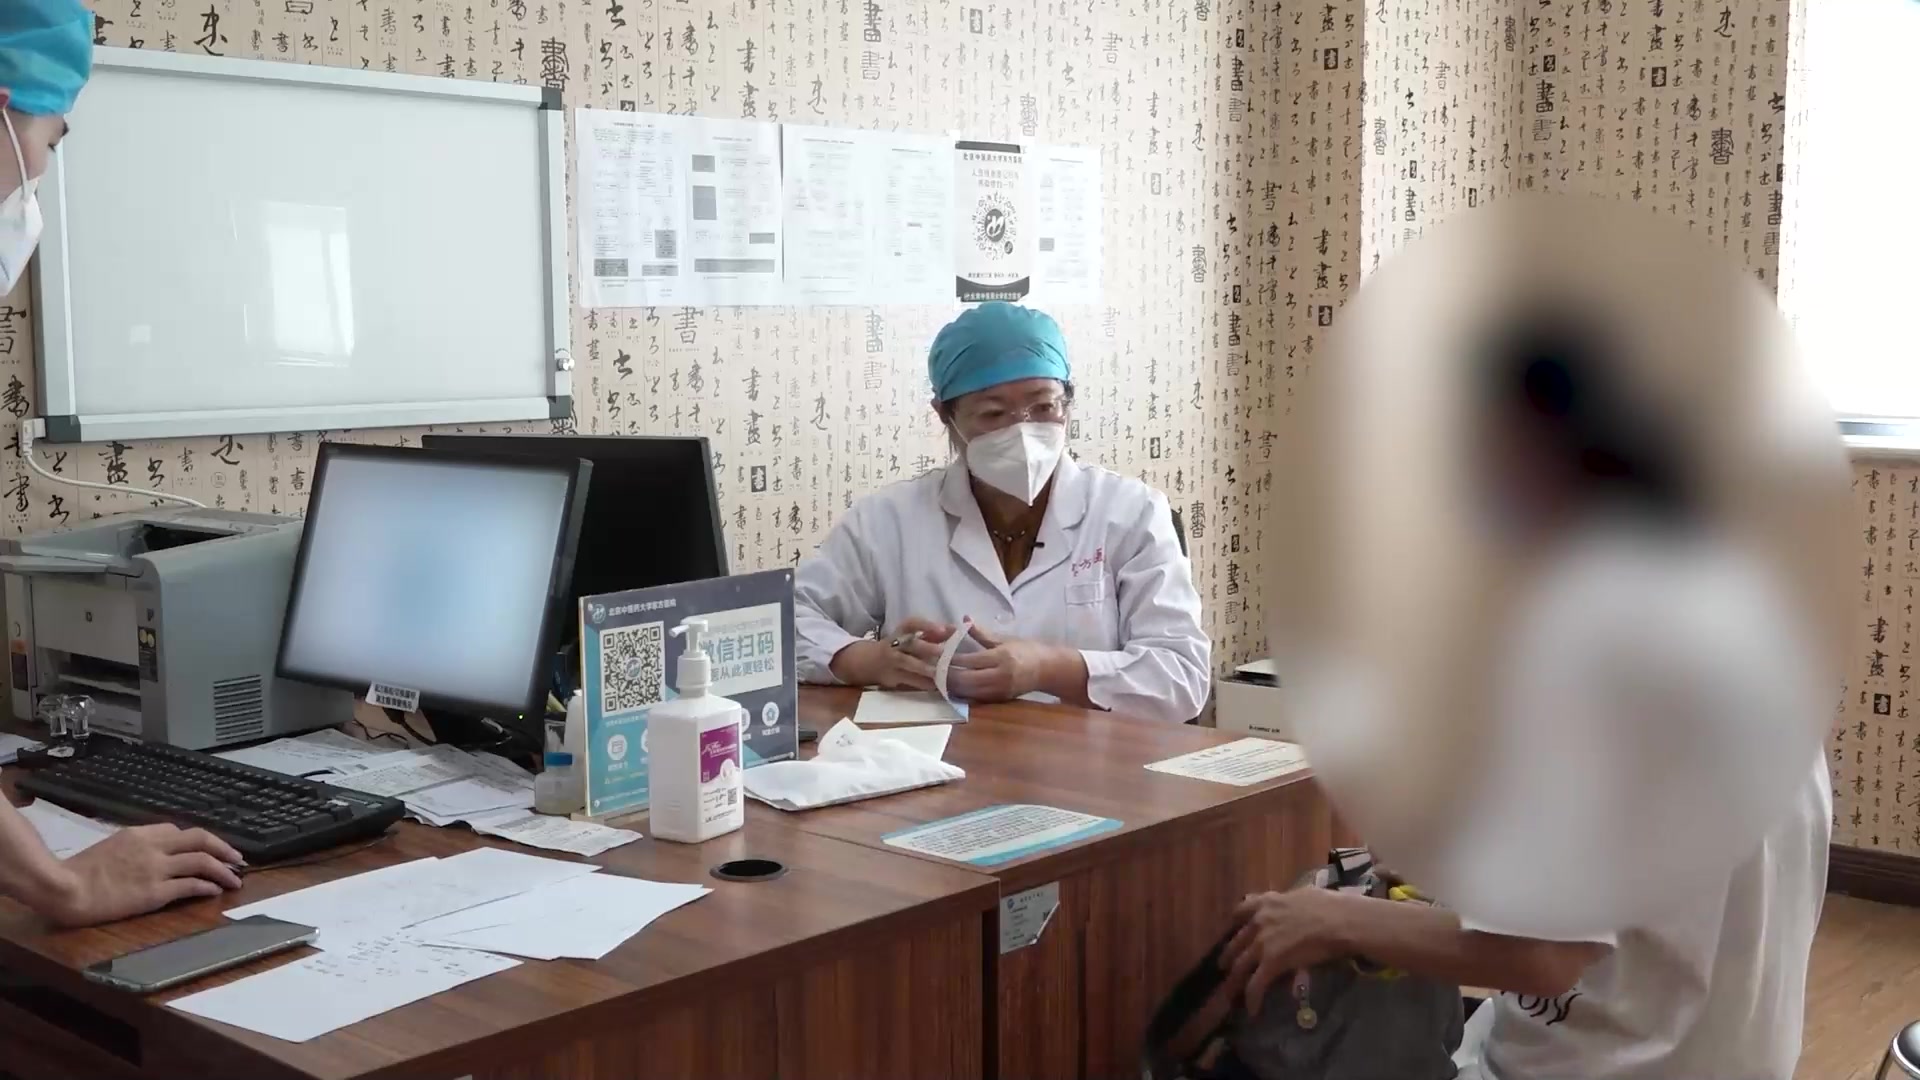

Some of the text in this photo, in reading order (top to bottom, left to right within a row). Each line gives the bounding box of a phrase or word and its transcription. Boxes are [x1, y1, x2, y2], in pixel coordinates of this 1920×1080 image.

[608, 598, 677, 617] 北京中医药大学东方医院
